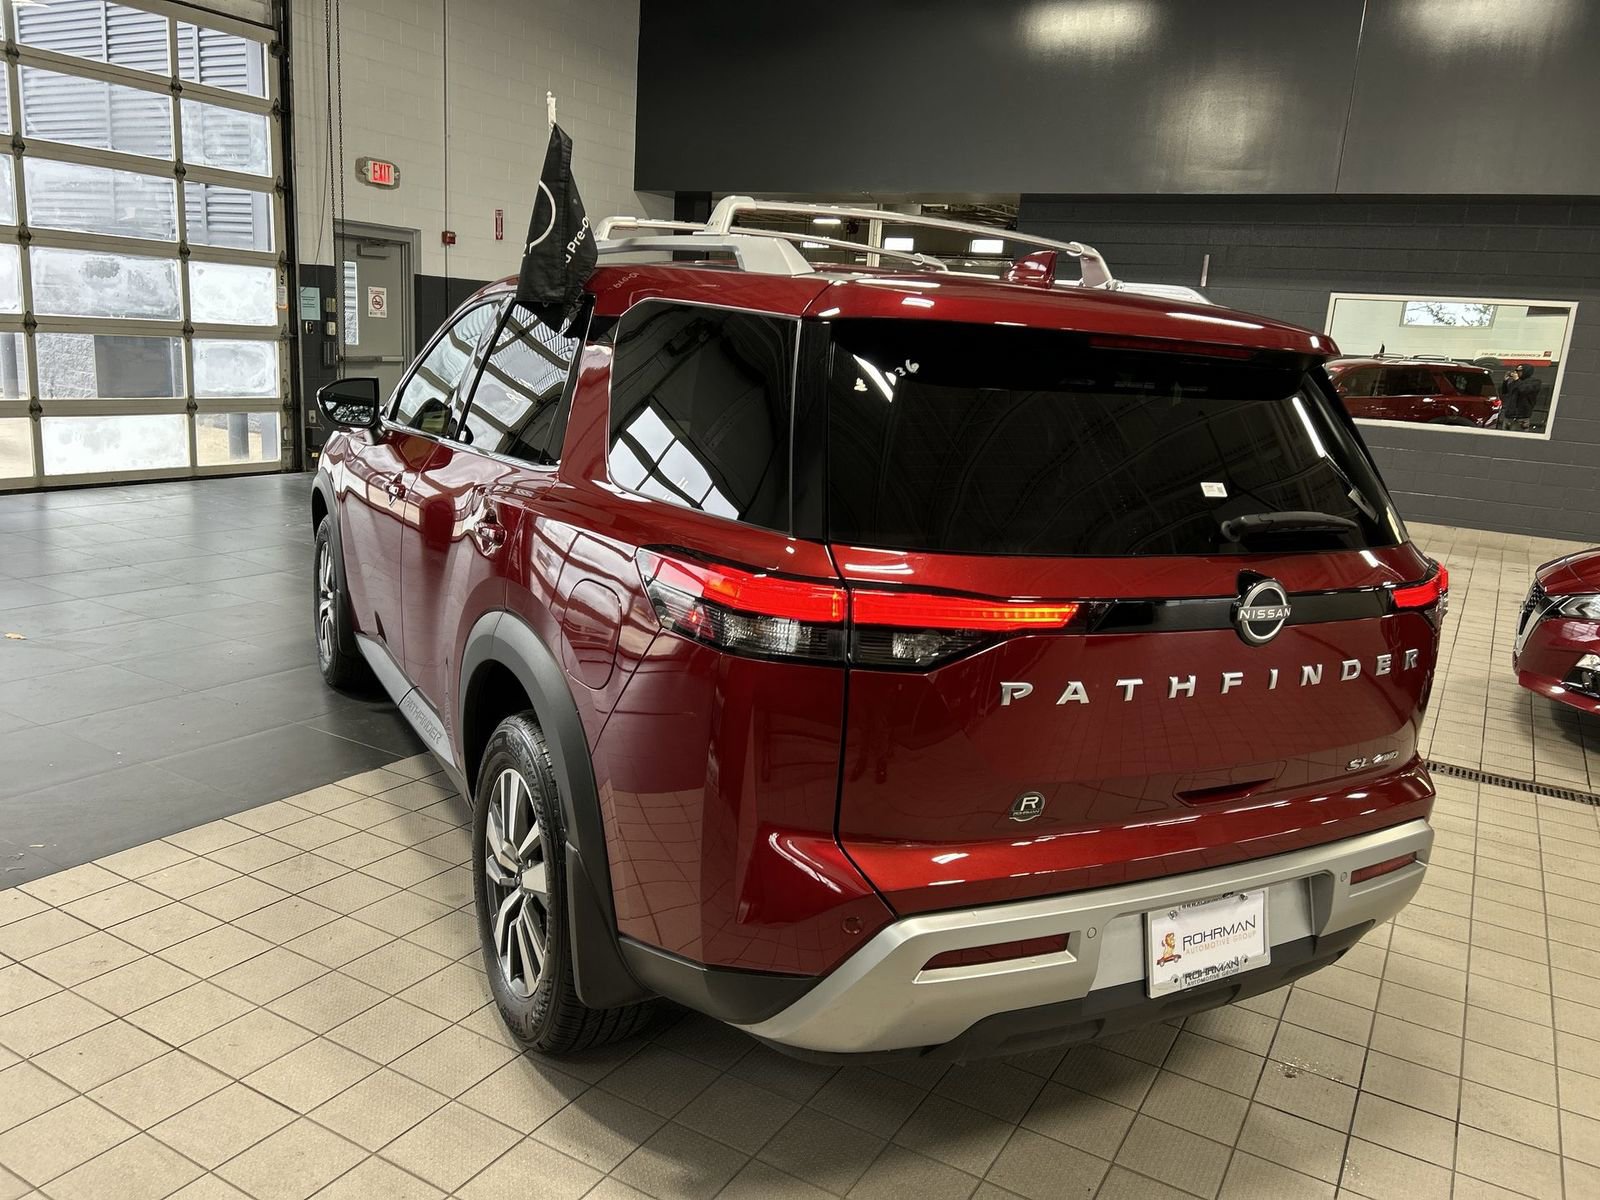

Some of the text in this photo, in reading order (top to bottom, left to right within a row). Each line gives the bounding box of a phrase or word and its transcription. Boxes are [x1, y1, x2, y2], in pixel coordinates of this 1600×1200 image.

[373, 162, 391, 182] EXIT
[566, 216, 590, 253] Pre-O
[1240, 607, 1291, 619] NISSAN
[1000, 648, 1418, 706] PATHFINDER
[403, 698, 442, 744] PATHFINDER
[1346, 757, 1369, 771] SL
[1020, 796, 1040, 811] R
[1182, 914, 1256, 951] ROHRMAN
[1186, 929, 1257, 955] AUTOMOTIVE GROUP
[1184, 956, 1240, 984] ROHRMAN
